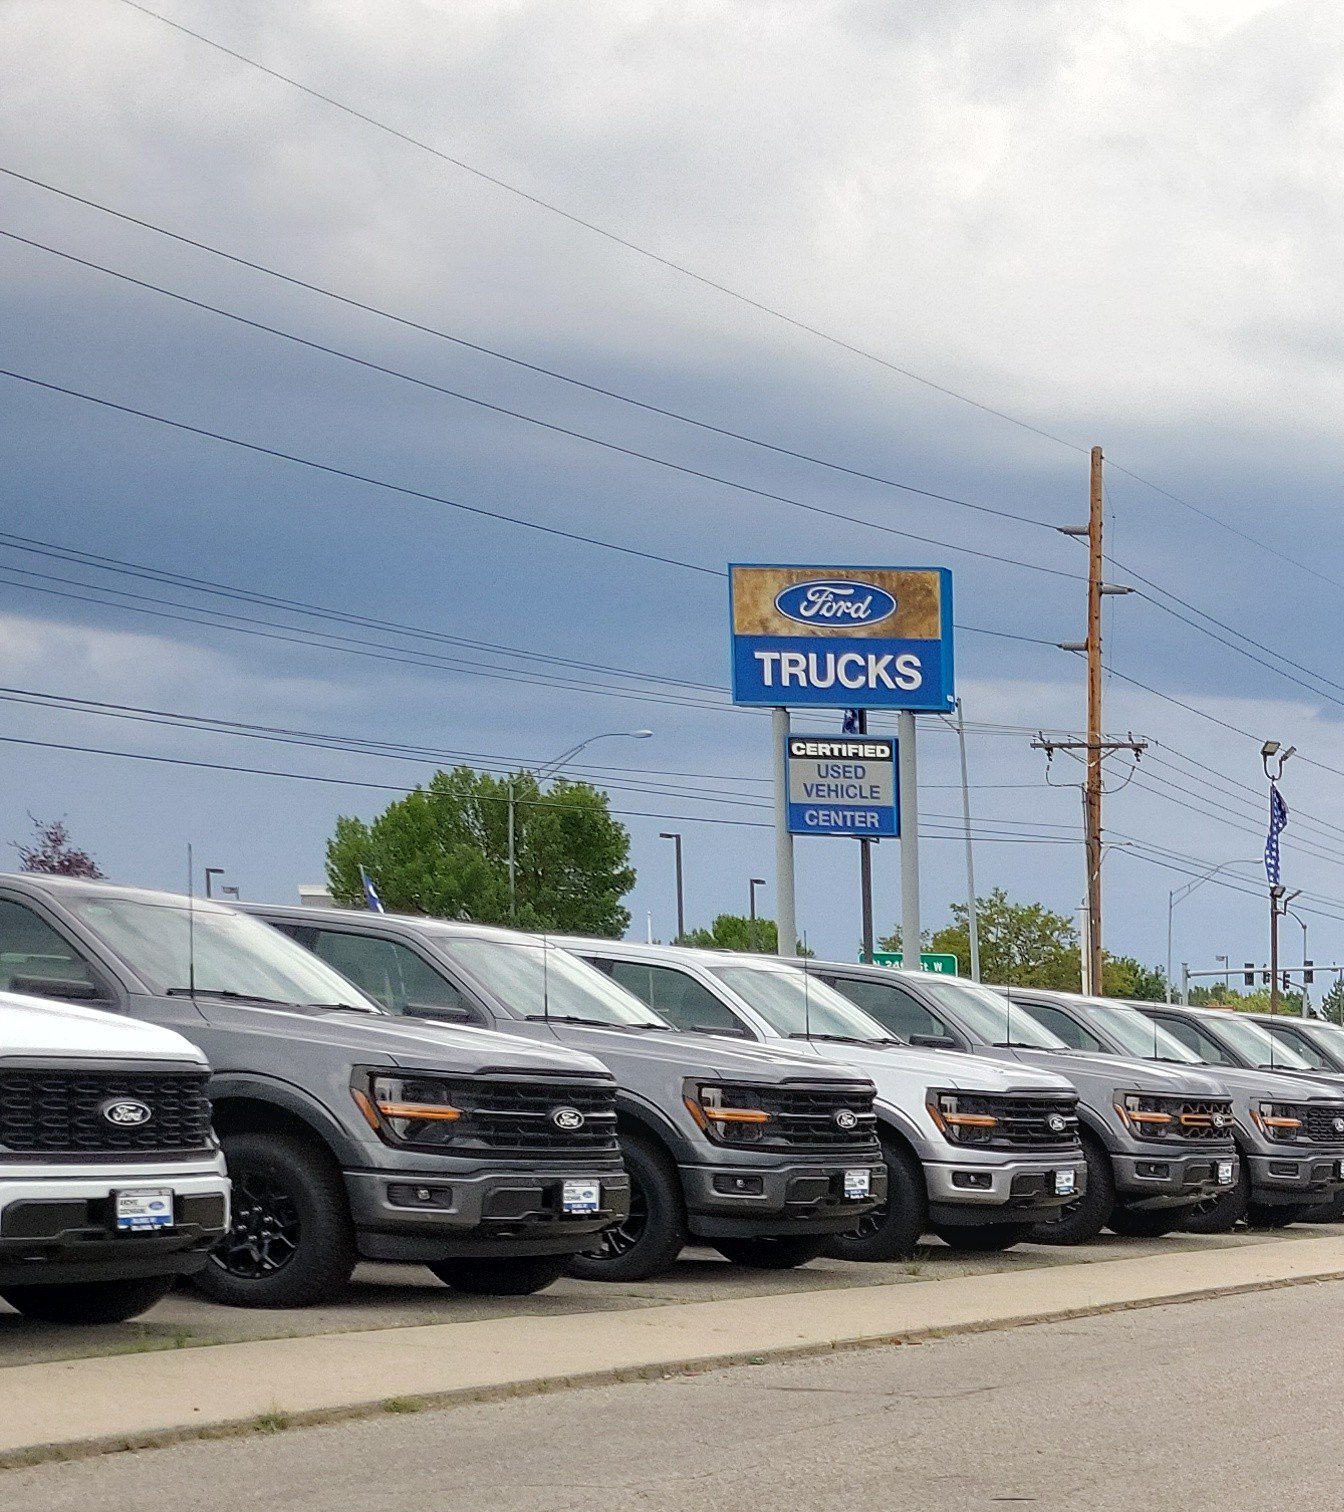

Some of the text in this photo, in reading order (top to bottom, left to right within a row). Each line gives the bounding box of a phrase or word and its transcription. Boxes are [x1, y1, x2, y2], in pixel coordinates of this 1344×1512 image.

[800, 586, 872, 620] Ford
[754, 651, 922, 691] TRUCKS
[791, 742, 890, 758] CERTIFIED
[817, 763, 866, 780] USED
[803, 782, 880, 800] VEHICLE
[805, 809, 879, 828] CENTER
[933, 962, 943, 971] W
